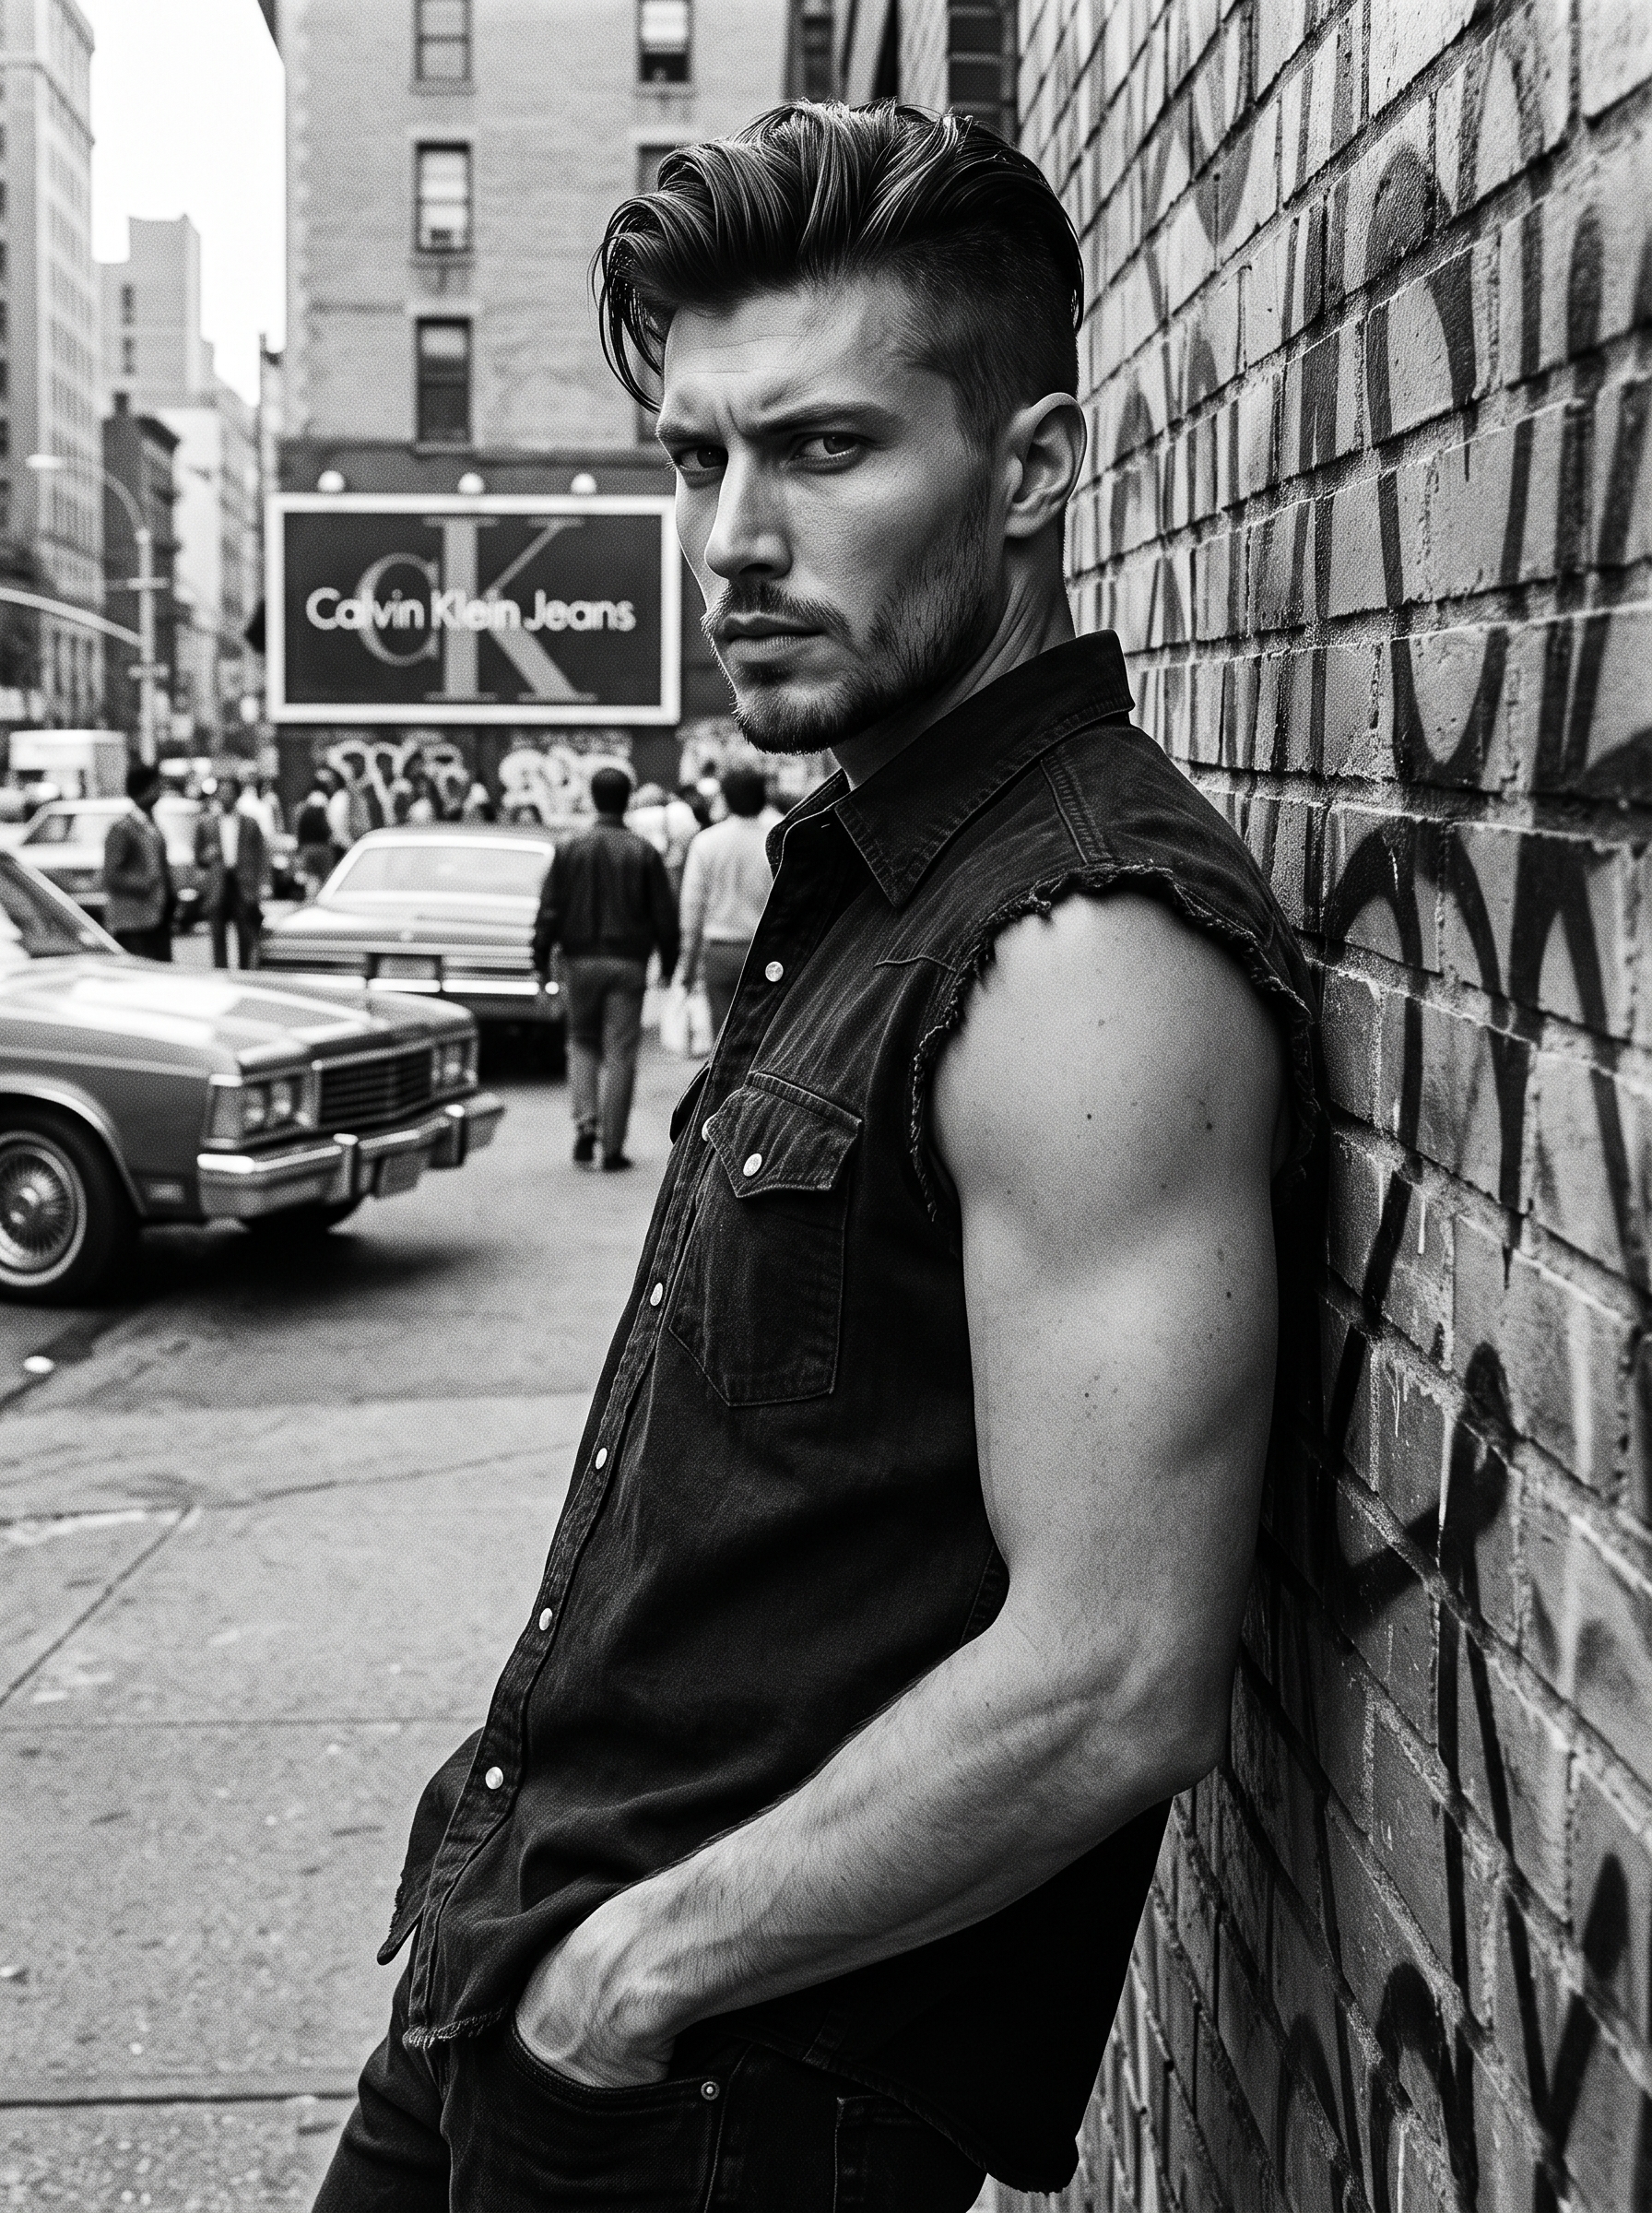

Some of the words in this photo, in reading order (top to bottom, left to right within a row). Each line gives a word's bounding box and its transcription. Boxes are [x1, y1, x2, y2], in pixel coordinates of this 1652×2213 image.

[305, 586, 425, 631] Calvin
[431, 587, 521, 632] Klein
[523, 587, 636, 632] Jeans
